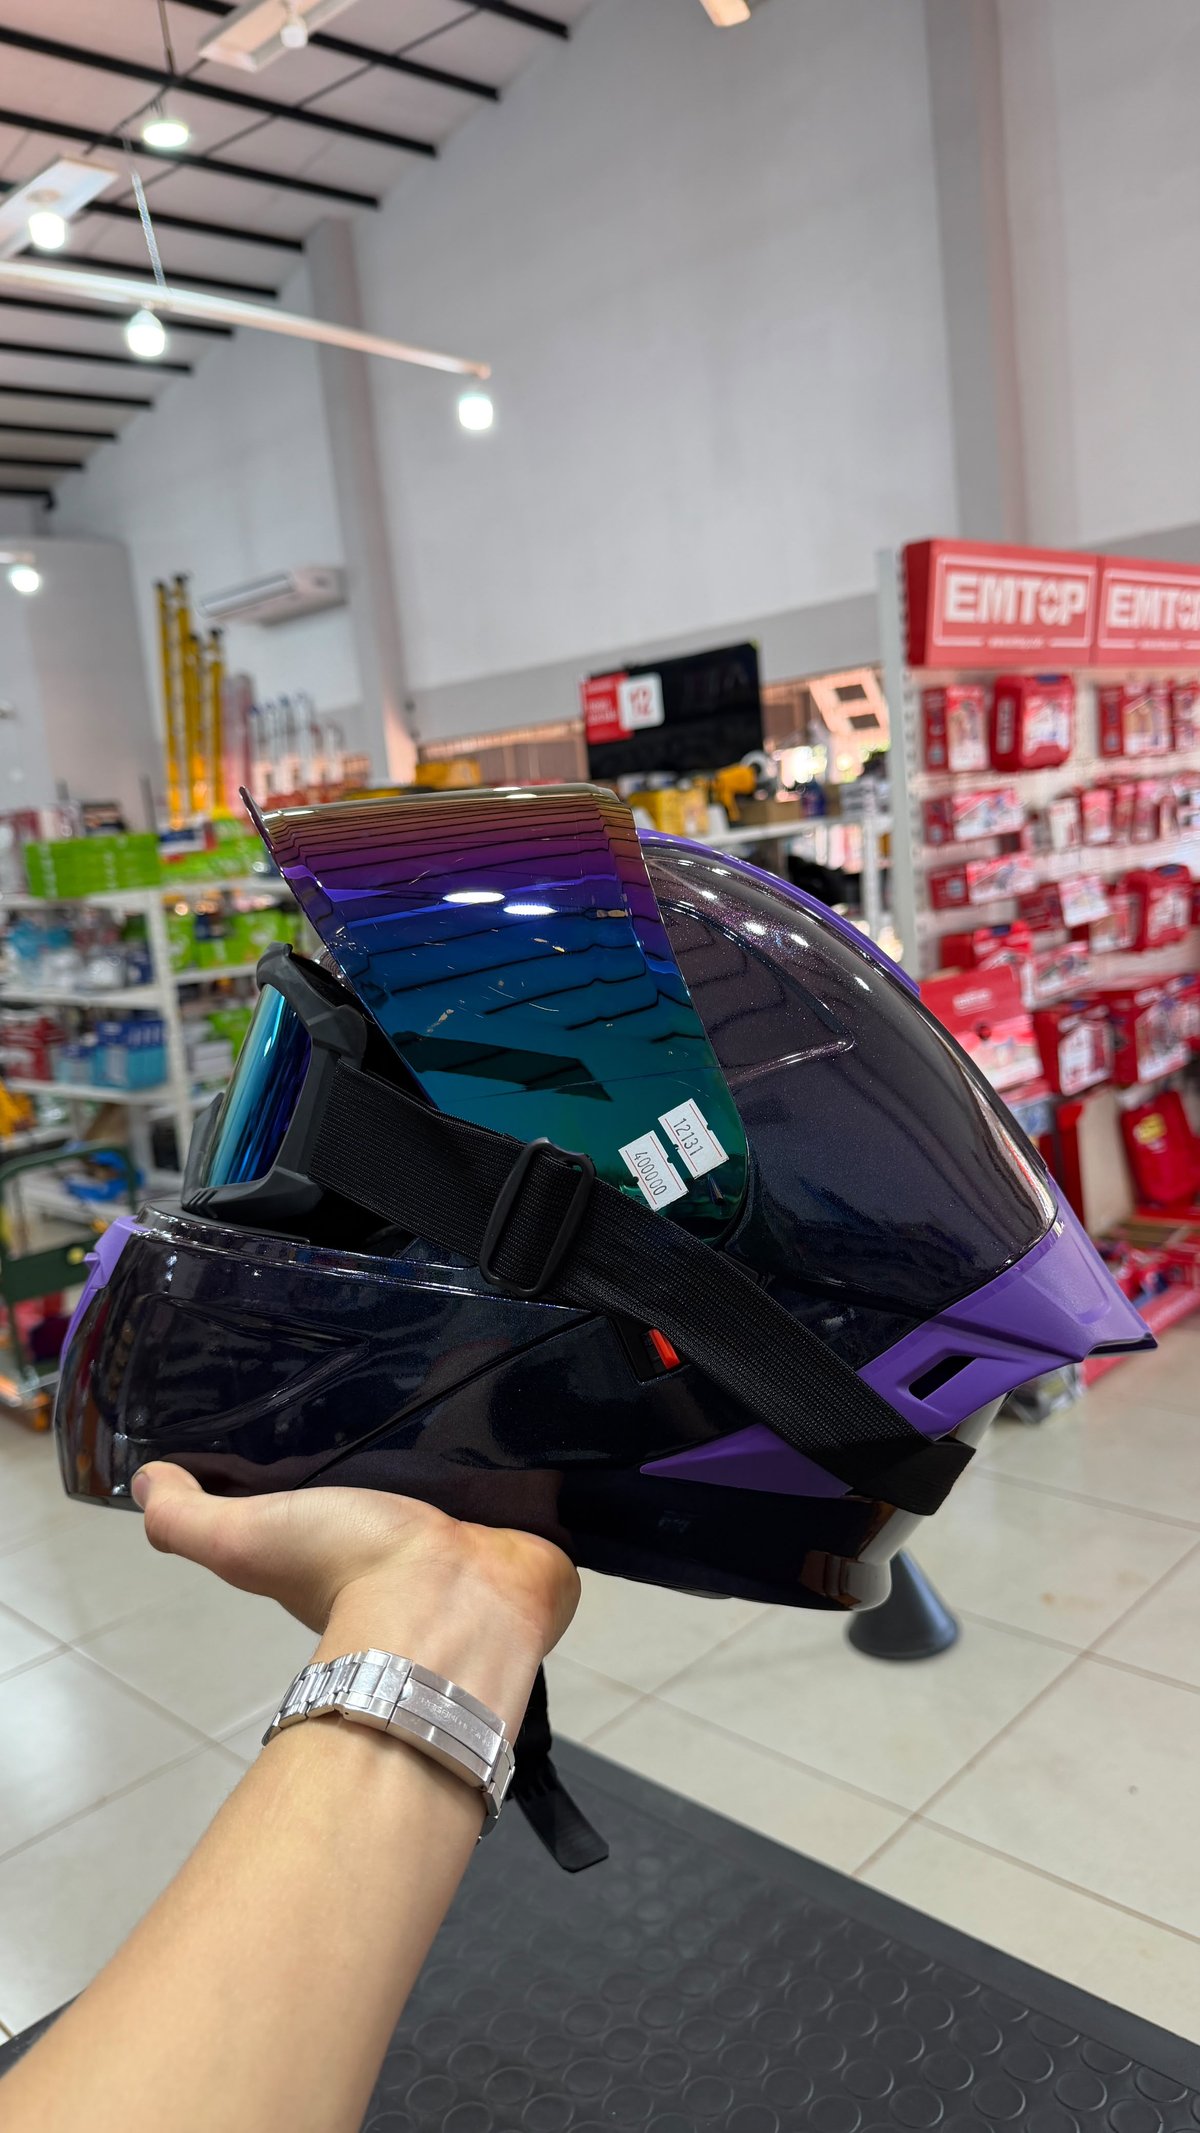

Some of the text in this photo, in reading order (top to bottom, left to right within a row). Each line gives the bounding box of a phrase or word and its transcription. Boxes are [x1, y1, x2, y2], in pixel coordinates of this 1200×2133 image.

[945, 571, 1087, 627] EMTOP
[673, 1117, 704, 1157] 12131
[633, 1151, 668, 1196] 400000
